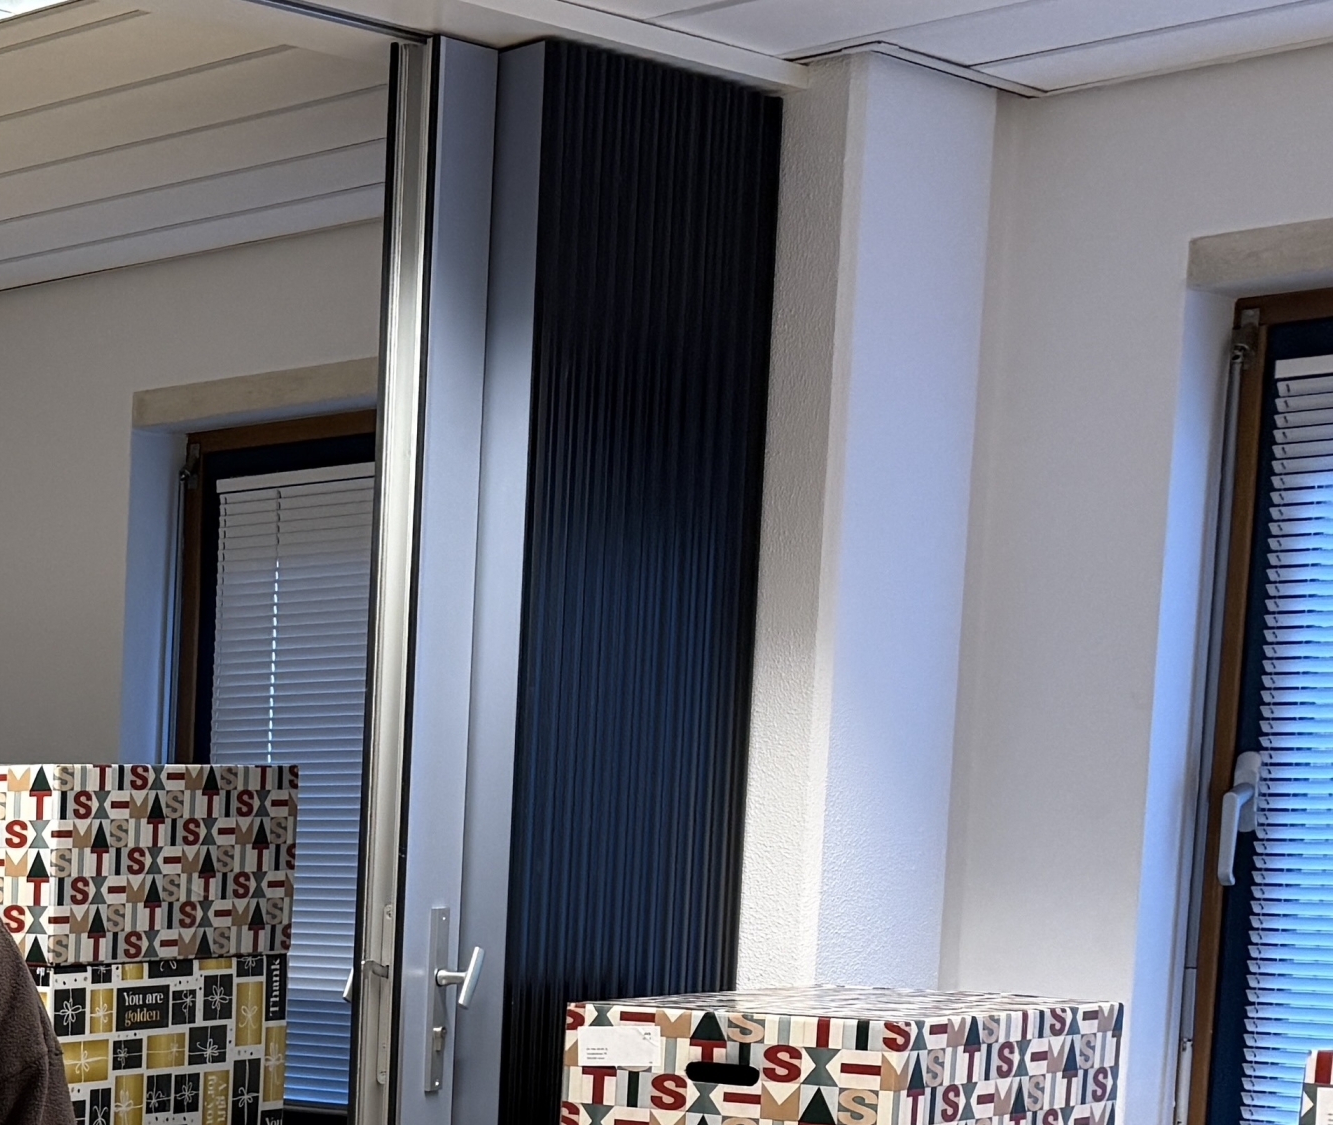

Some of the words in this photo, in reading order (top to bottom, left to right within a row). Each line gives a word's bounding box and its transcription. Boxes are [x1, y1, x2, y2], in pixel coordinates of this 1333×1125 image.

[269, 958, 280, 1017] Thank
[123, 991, 143, 1006] You
[146, 991, 164, 1005] are
[124, 1007, 160, 1027] golden
